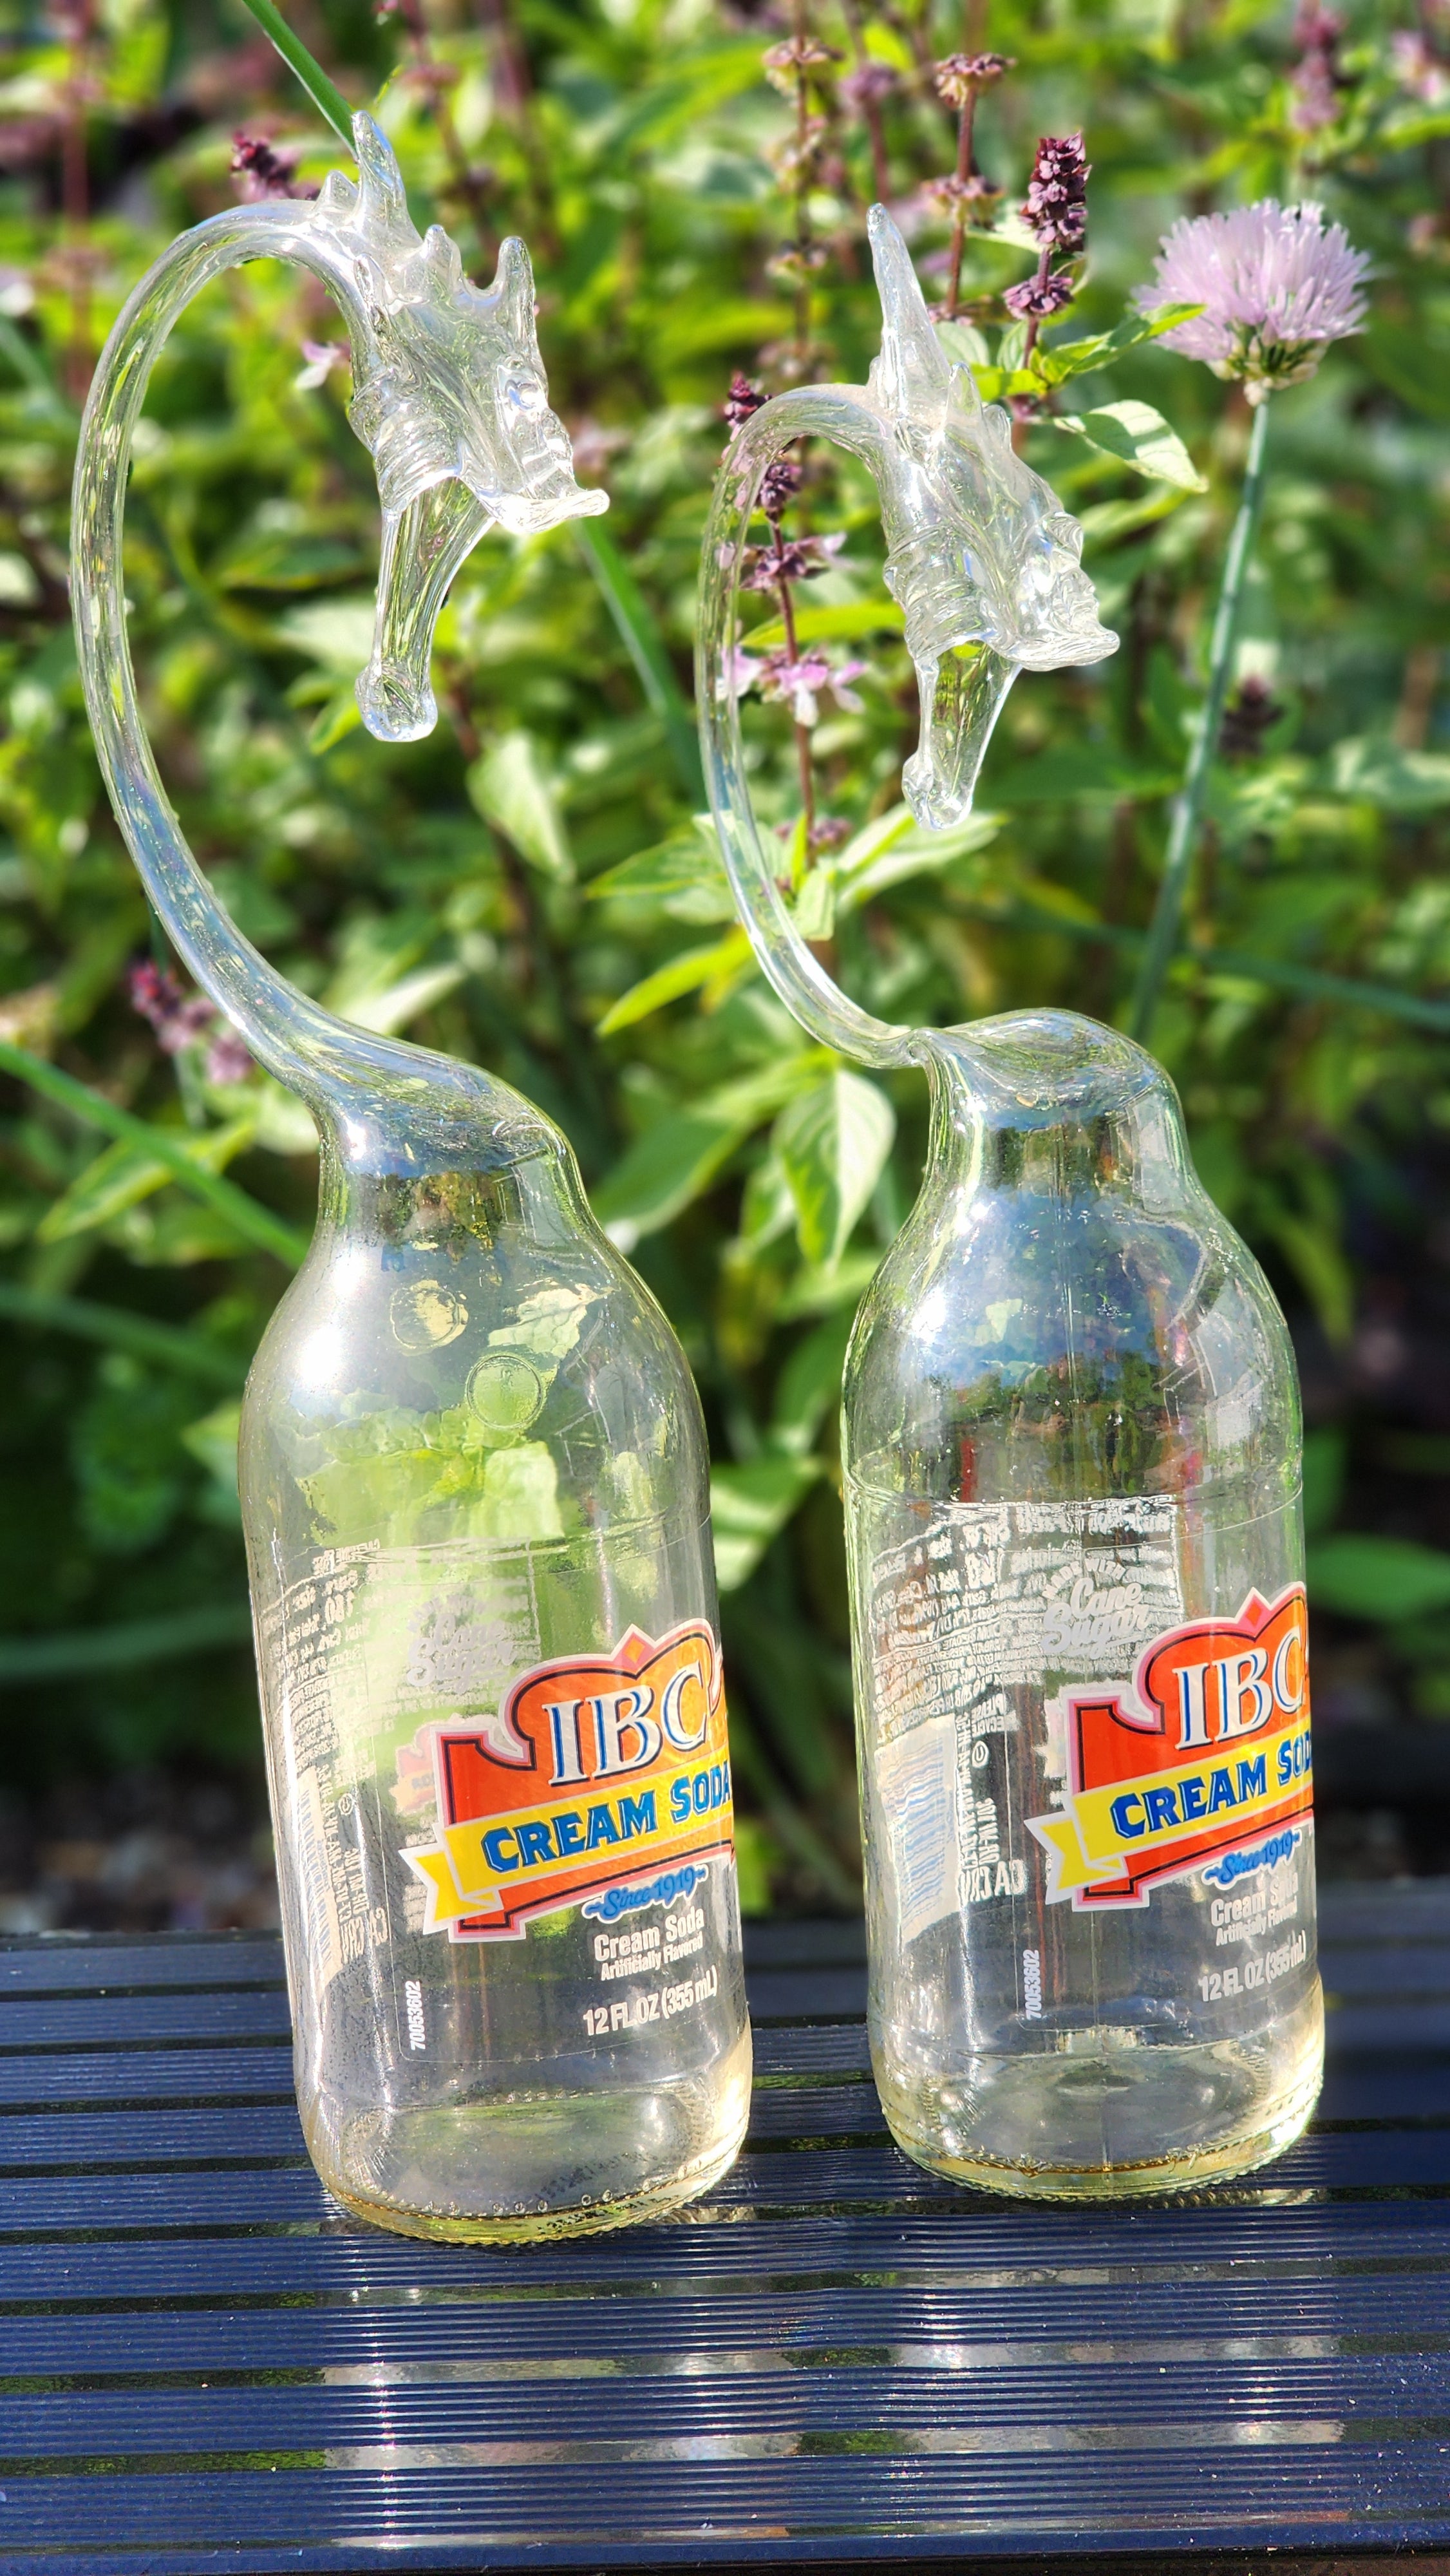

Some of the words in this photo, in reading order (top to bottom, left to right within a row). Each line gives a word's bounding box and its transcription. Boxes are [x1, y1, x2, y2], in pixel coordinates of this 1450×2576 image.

[1042, 1561, 1082, 1600] MADE
[1085, 1558, 1125, 1580] WITH
[1070, 1578, 1142, 1618] Cane
[433, 1613, 505, 1653] Cane
[1040, 1602, 1151, 1660] Sugar
[406, 1638, 516, 1695] Sugar
[1172, 1626, 1303, 1750] IBC
[541, 1660, 707, 1787] IBC
[481, 1790, 657, 1873] CREAM
[670, 1760, 731, 1824] SODA
[1110, 1753, 1266, 1839] CREAM
[1219, 1851, 1261, 1884] Since
[1263, 1829, 1294, 1869] 1919
[603, 1886, 651, 1920] Since
[654, 1865, 695, 1902] 1919
[1210, 1891, 1266, 1927] Cream
[1270, 1872, 1298, 1906] Soda
[594, 1926, 660, 1962] Cream
[664, 1906, 704, 1942] Soda
[1216, 1915, 1266, 1946] Artificially
[1268, 1896, 1297, 1927] Flavored
[601, 1950, 661, 1981] Artificially
[663, 1931, 703, 1964] Flavored
[1198, 1973, 1222, 2002] 12
[1223, 1967, 1244, 1996] FL
[1244, 1958, 1265, 1990] OZ
[583, 2007, 609, 2036] 12
[636, 1993, 660, 2024] OZ
[661, 1981, 694, 2019] (355
[695, 1964, 718, 2003] mL)
[1023, 1949, 1042, 2020] 70053602
[405, 1980, 426, 2051] 70053602
